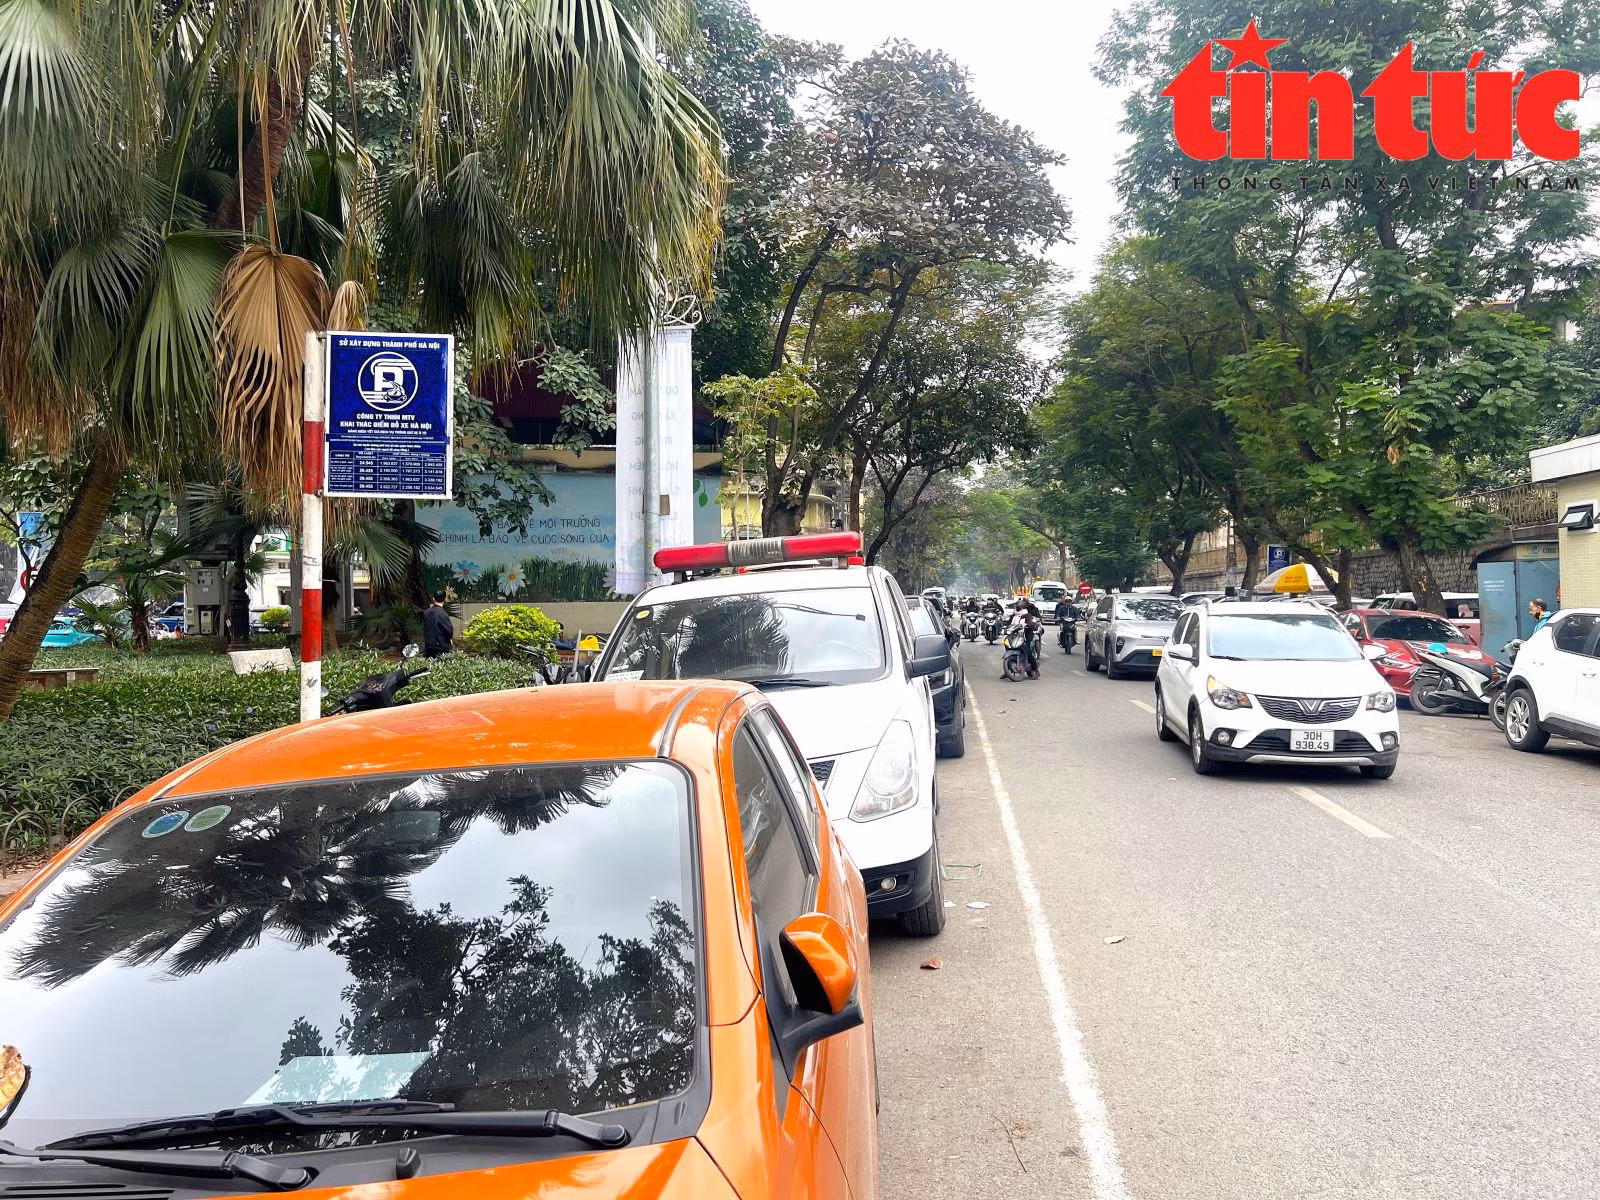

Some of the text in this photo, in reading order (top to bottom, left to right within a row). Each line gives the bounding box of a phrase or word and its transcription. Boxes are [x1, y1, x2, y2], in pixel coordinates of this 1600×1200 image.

[339, 338, 348, 346] SỞ
[363, 340, 380, 348] DỰNG
[382, 340, 402, 348] THÀNH
[428, 342, 440, 350] NỘI
[373, 420, 389, 428] ĐIỂM
[539, 518, 557, 529] MÔI
[560, 515, 601, 528] TRƯỜNG
[590, 530, 610, 543] CỦA
[1303, 731, 1322, 740] 30H
[1295, 741, 1330, 750] 938.49
